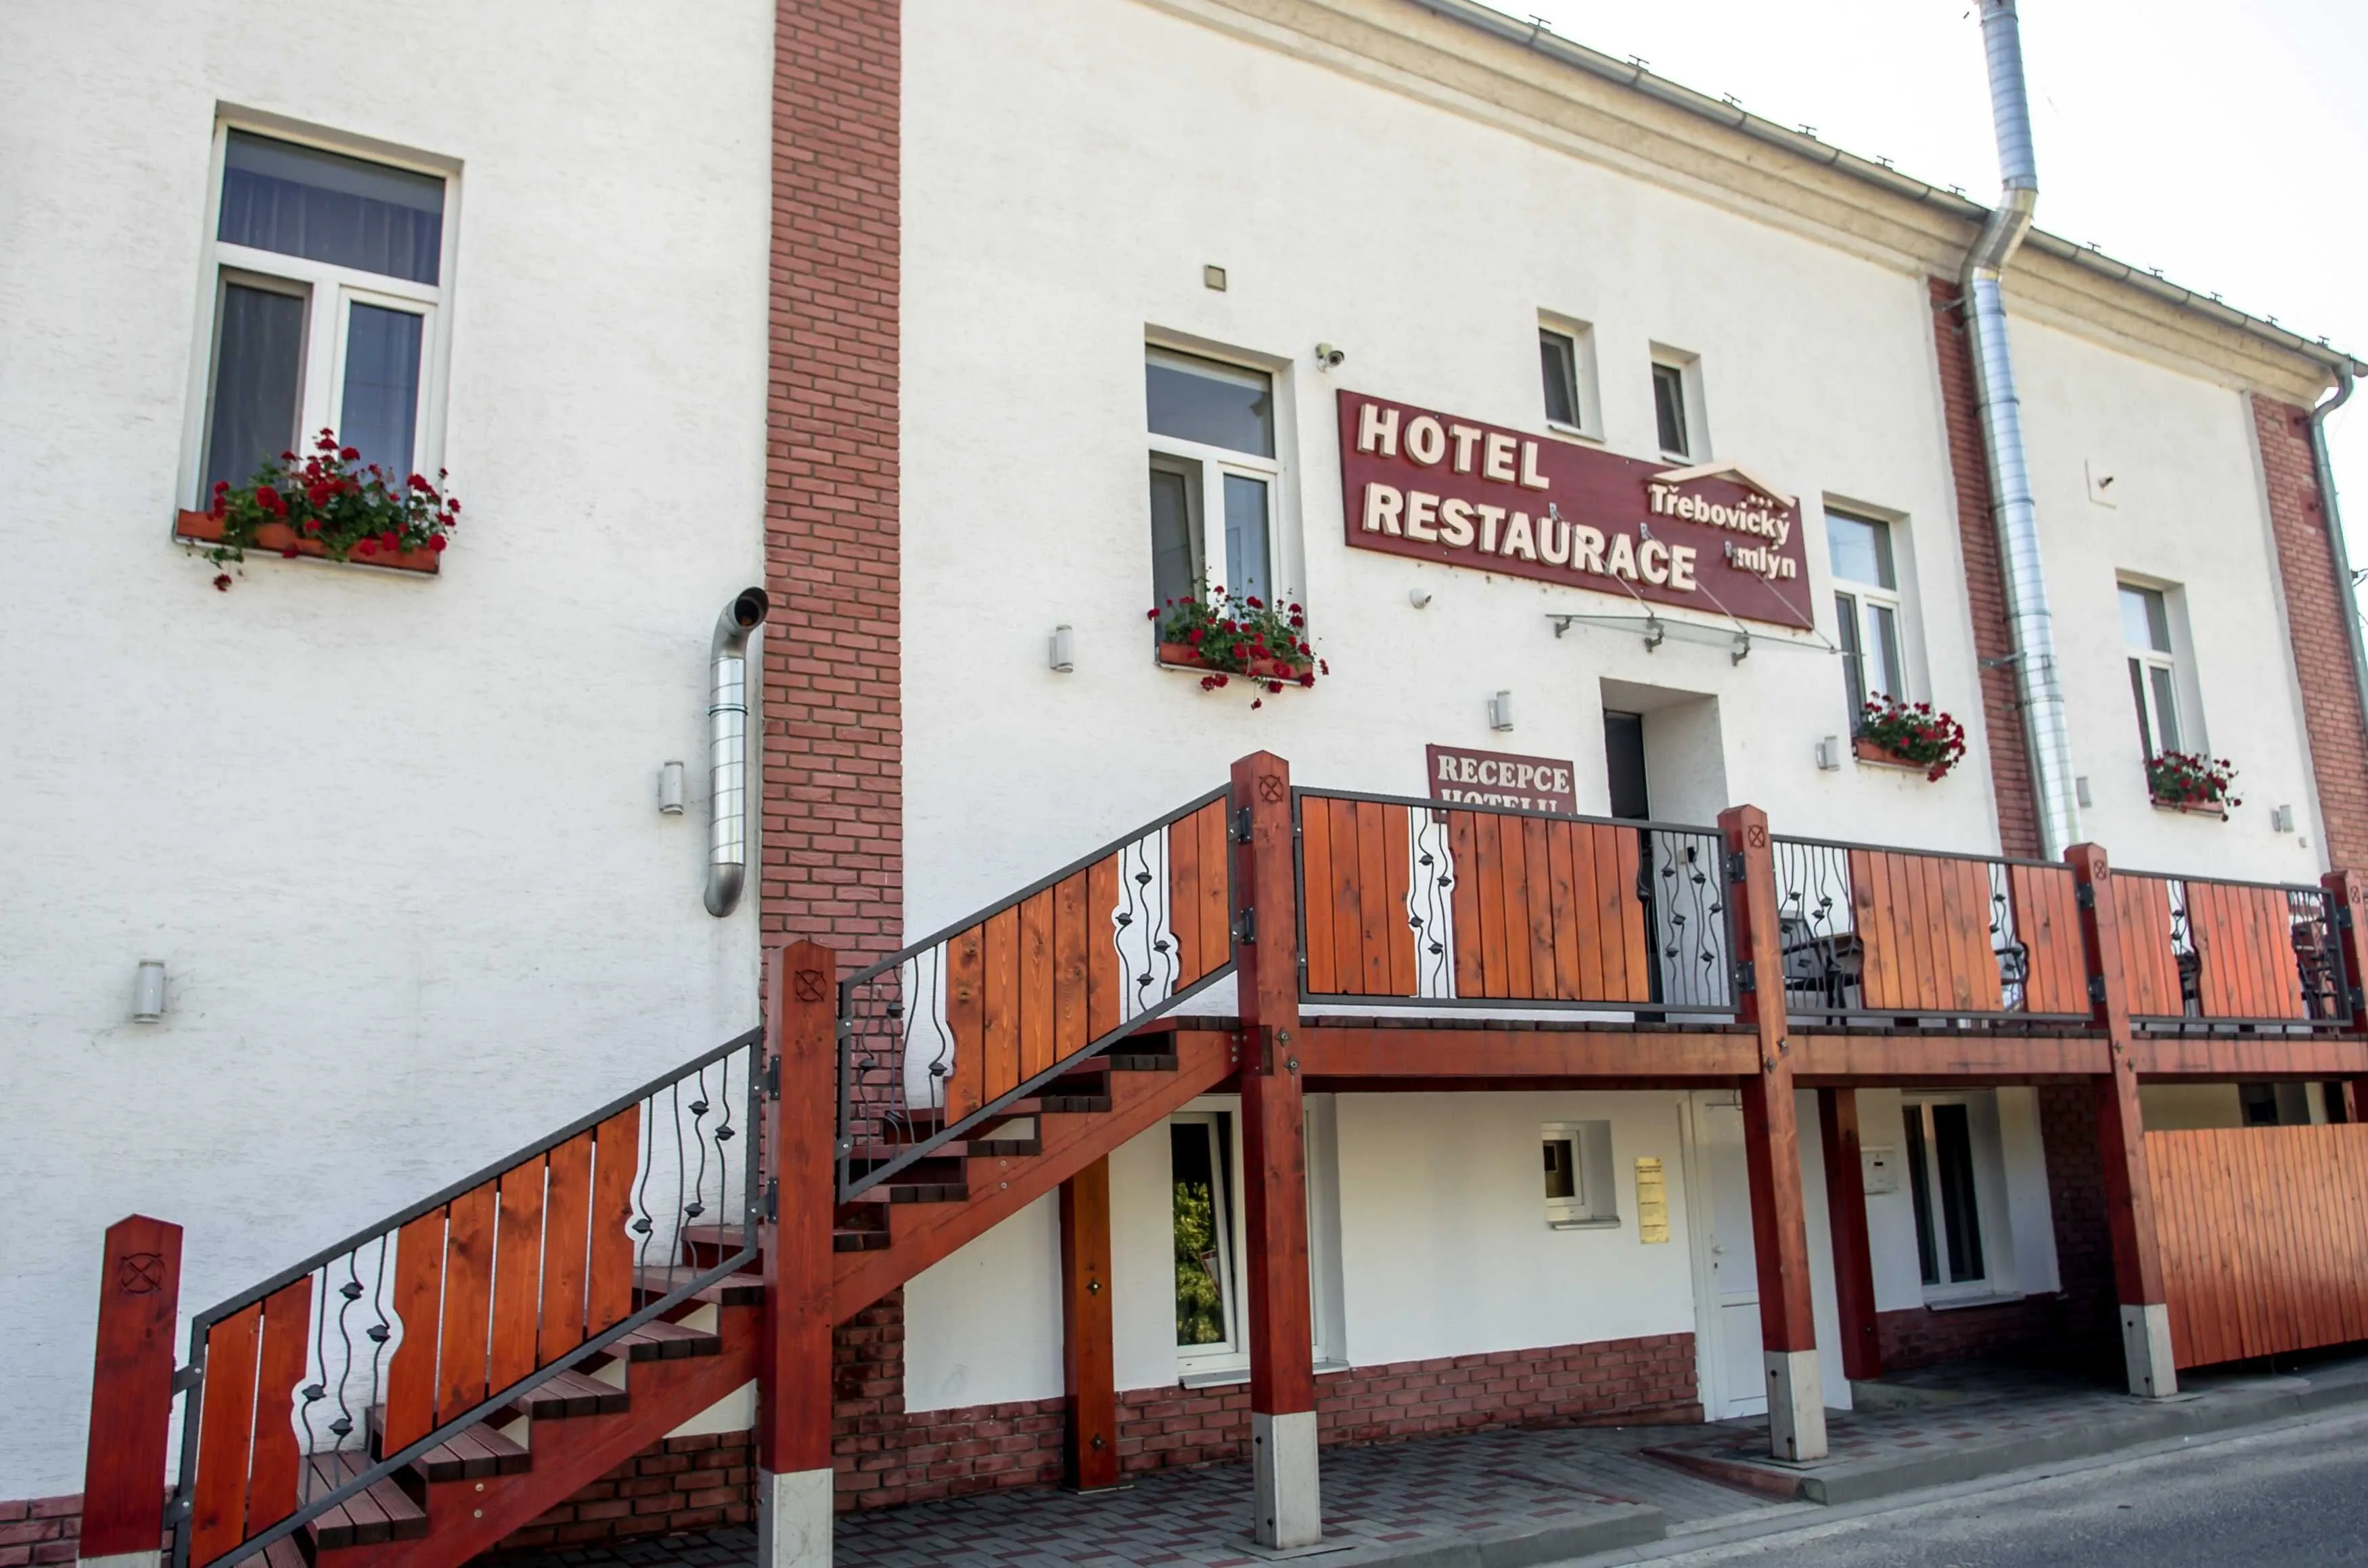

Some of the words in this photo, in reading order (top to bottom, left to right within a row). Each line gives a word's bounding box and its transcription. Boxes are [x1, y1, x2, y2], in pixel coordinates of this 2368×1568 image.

[1357, 403, 1550, 492] HOTEL
[1363, 482, 1697, 591] RESTAURACE
[1647, 483, 1790, 545] Třebovický
[1732, 545, 1797, 580] mlýn
[1437, 755, 1570, 793] RECEPCE
